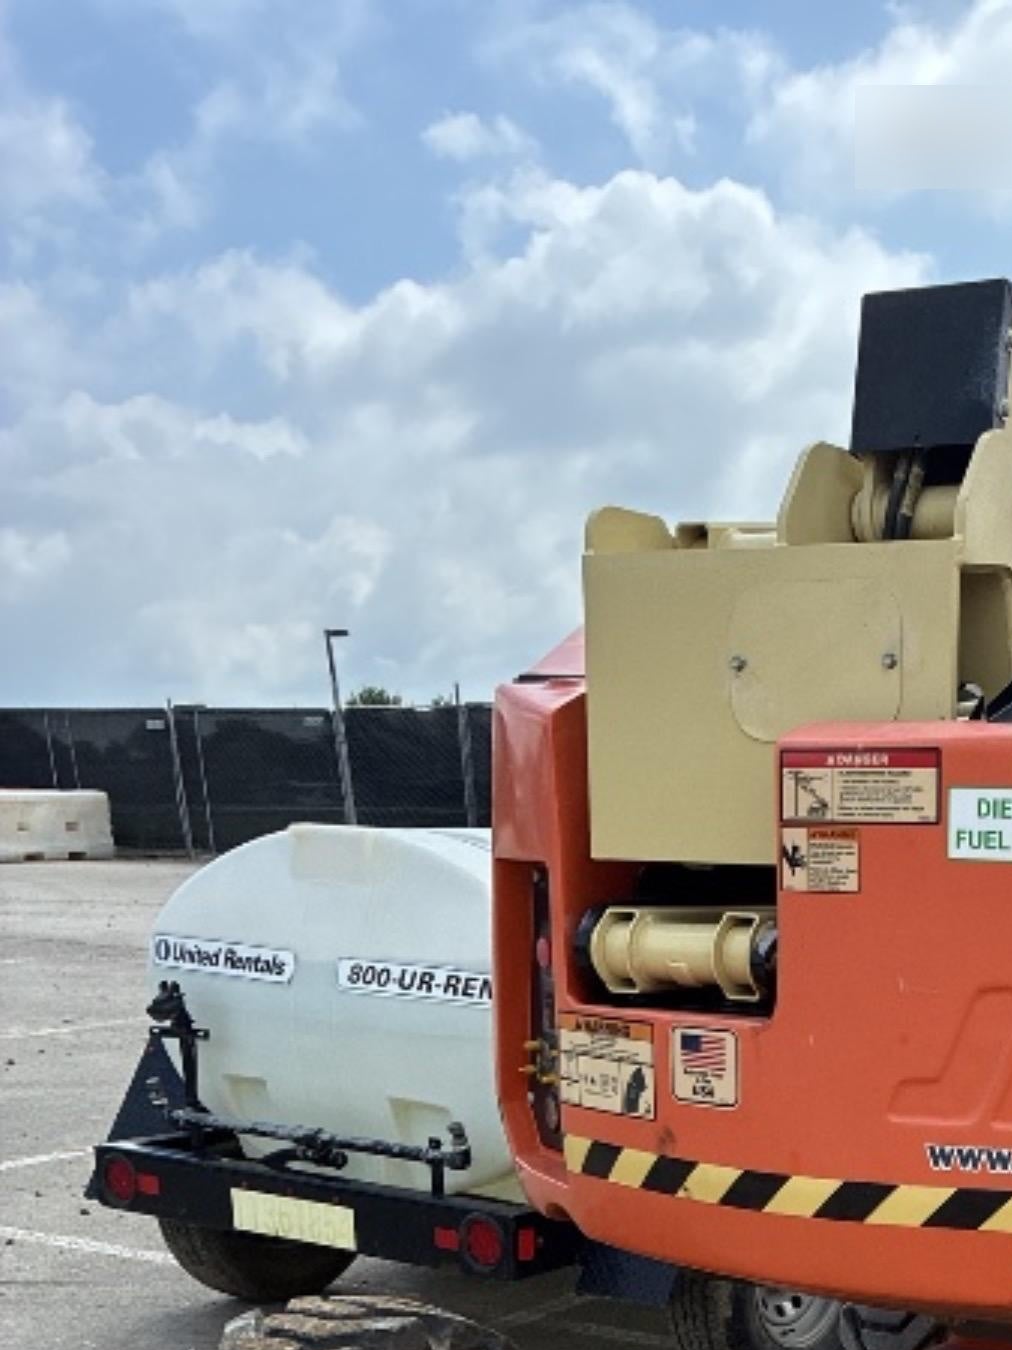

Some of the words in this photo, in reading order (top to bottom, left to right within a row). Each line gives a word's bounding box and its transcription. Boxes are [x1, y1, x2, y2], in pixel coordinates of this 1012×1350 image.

[956, 830, 1011, 850] FUEL
[172, 945, 222, 967] United
[223, 949, 286, 975] Rentals
